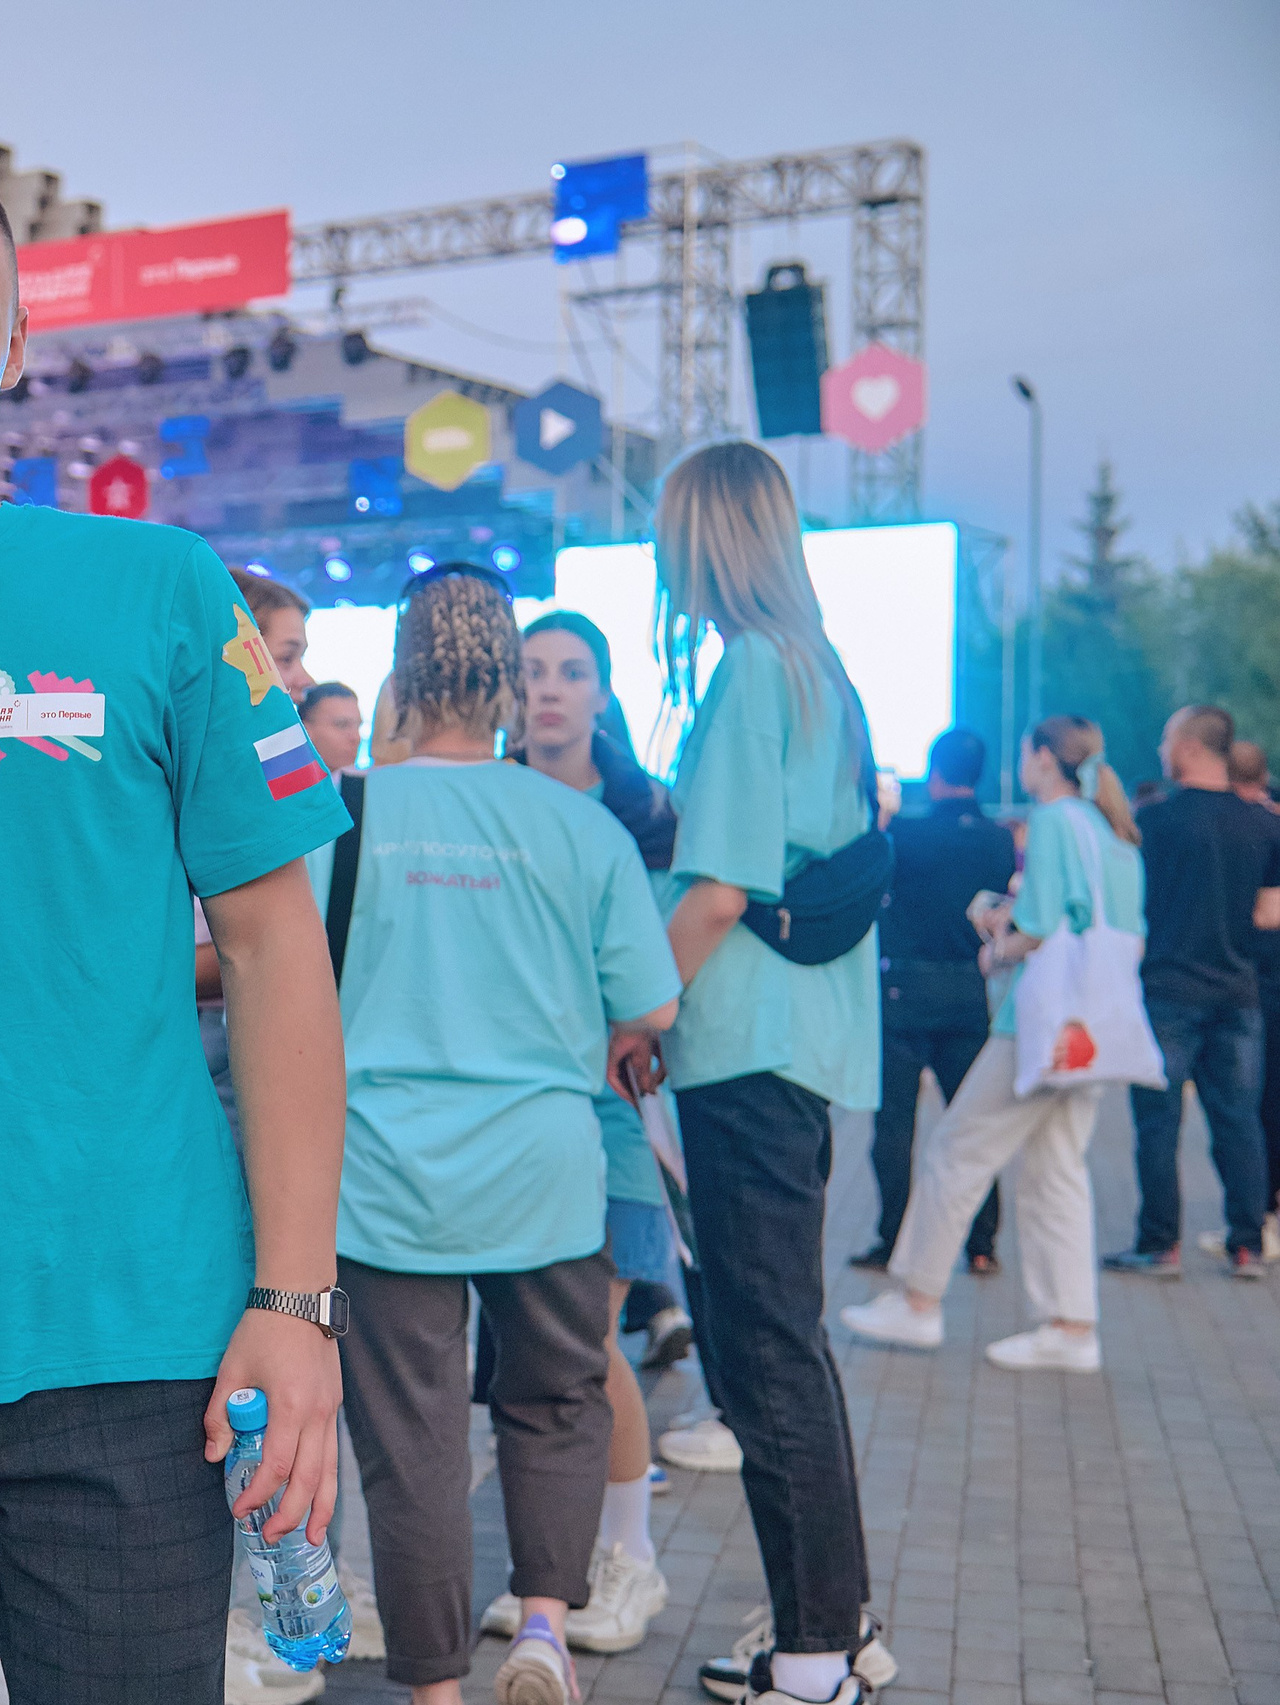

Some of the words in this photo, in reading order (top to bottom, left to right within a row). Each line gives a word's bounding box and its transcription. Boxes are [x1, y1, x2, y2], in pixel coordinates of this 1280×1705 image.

[242, 637, 272, 676] 11
[40, 711, 57, 719] это
[59, 710, 92, 720] Первые
